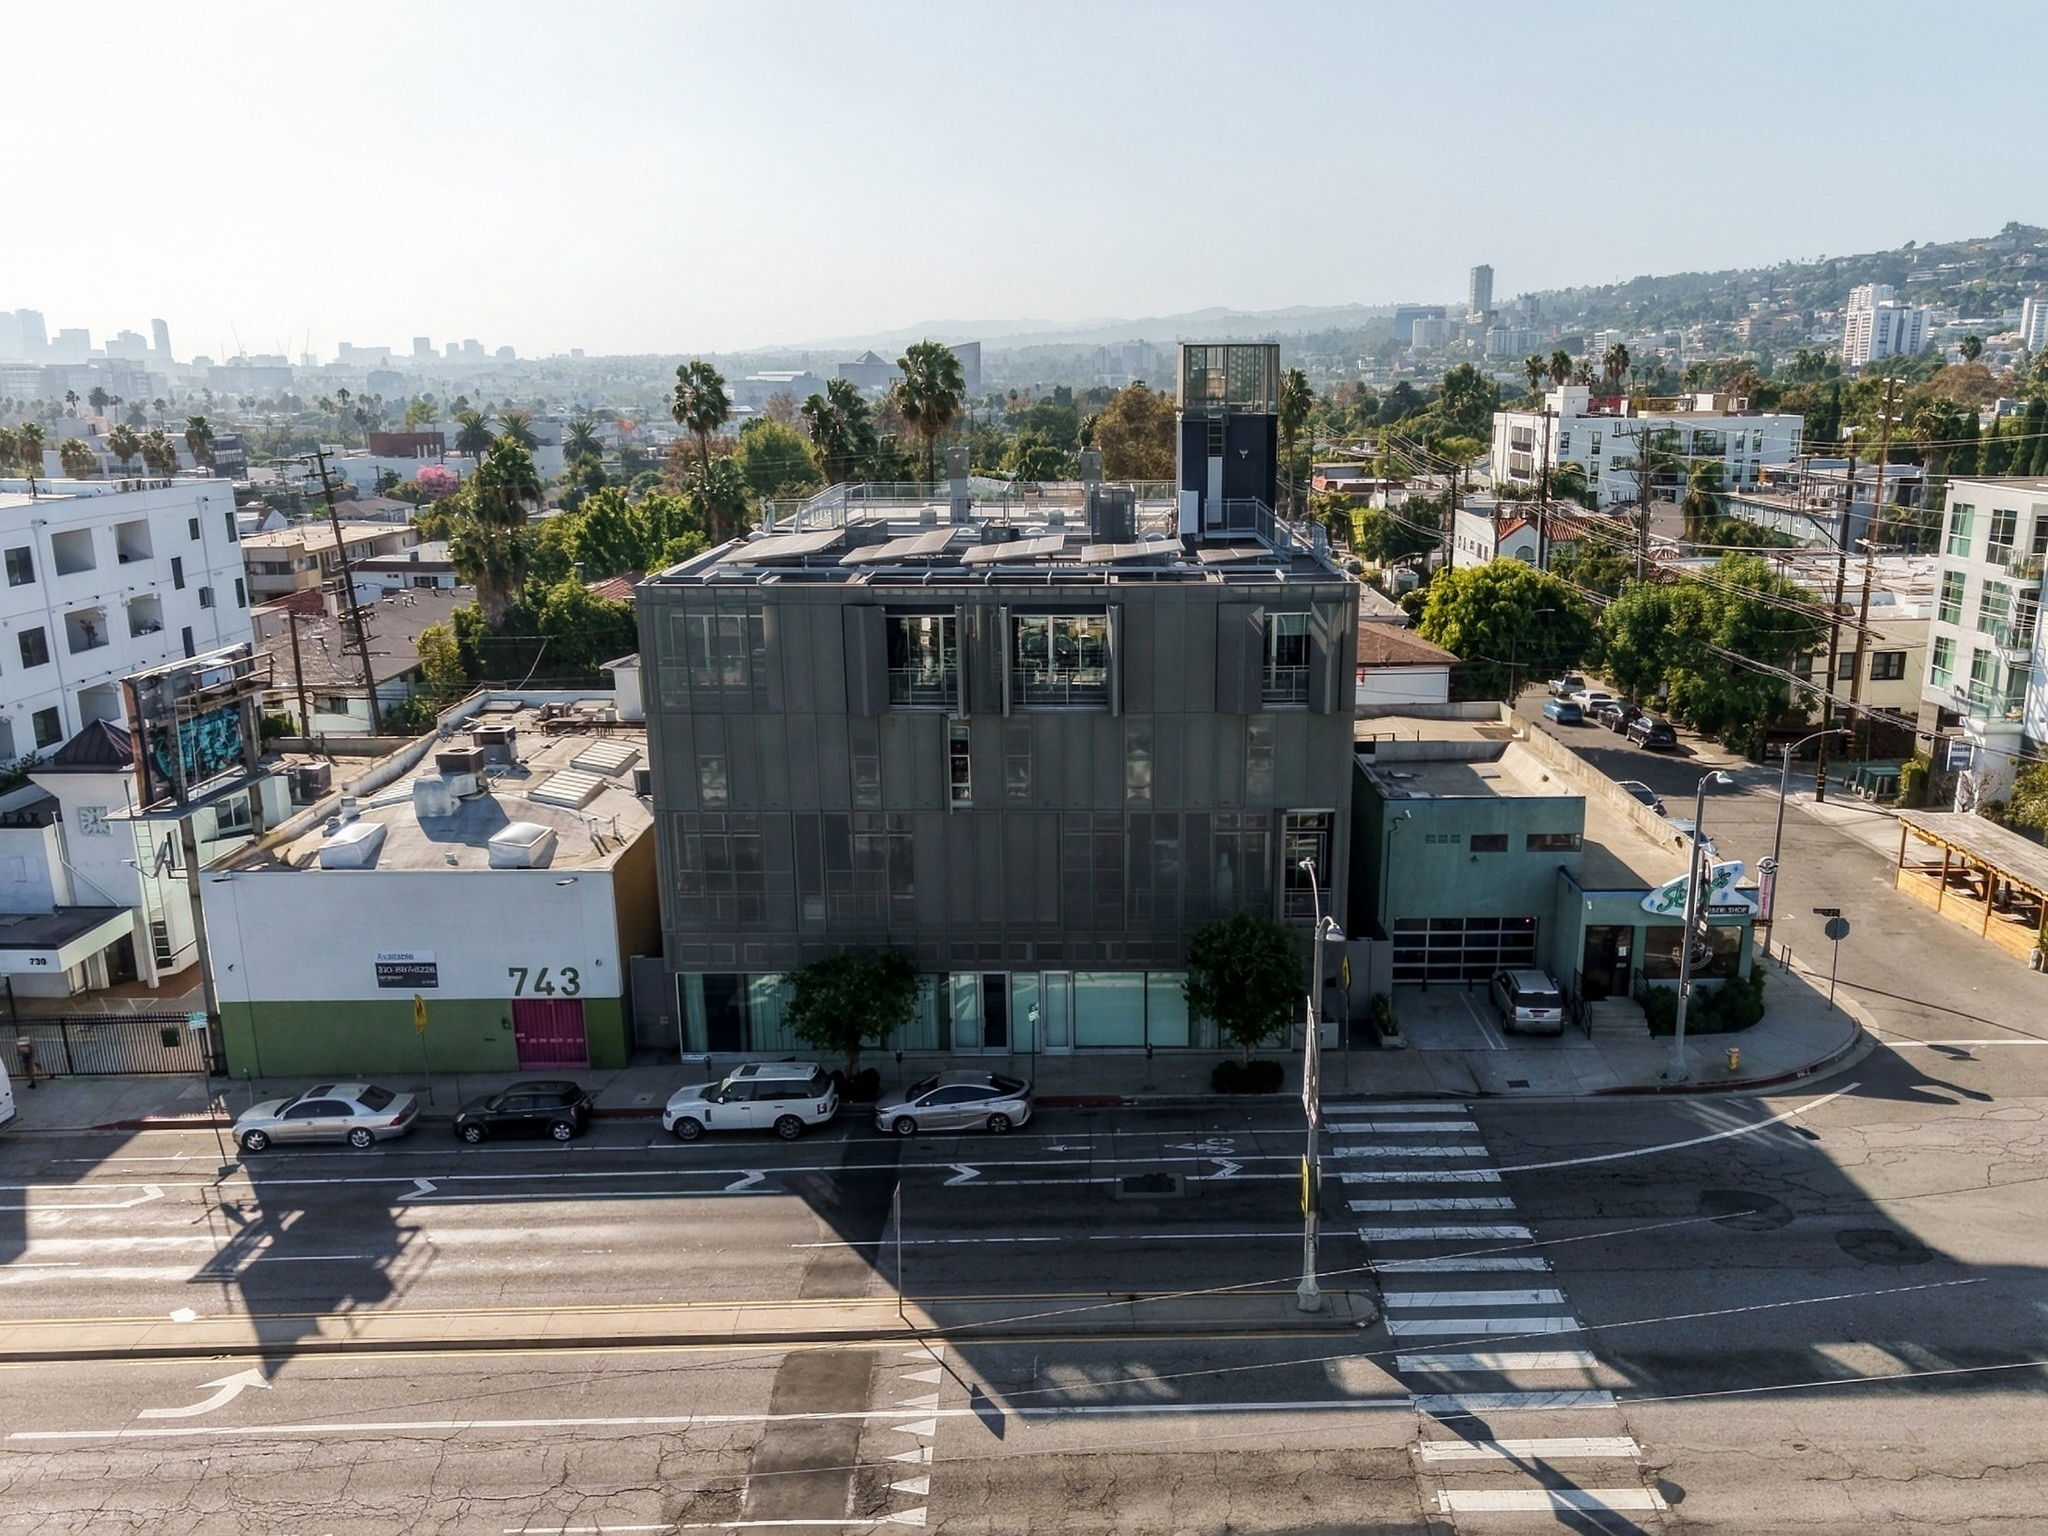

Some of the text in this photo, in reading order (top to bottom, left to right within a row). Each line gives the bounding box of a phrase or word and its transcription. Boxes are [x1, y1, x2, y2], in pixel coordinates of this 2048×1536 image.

[377, 952, 415, 961] Available
[29, 957, 47, 966] 739
[508, 967, 581, 996] 743
